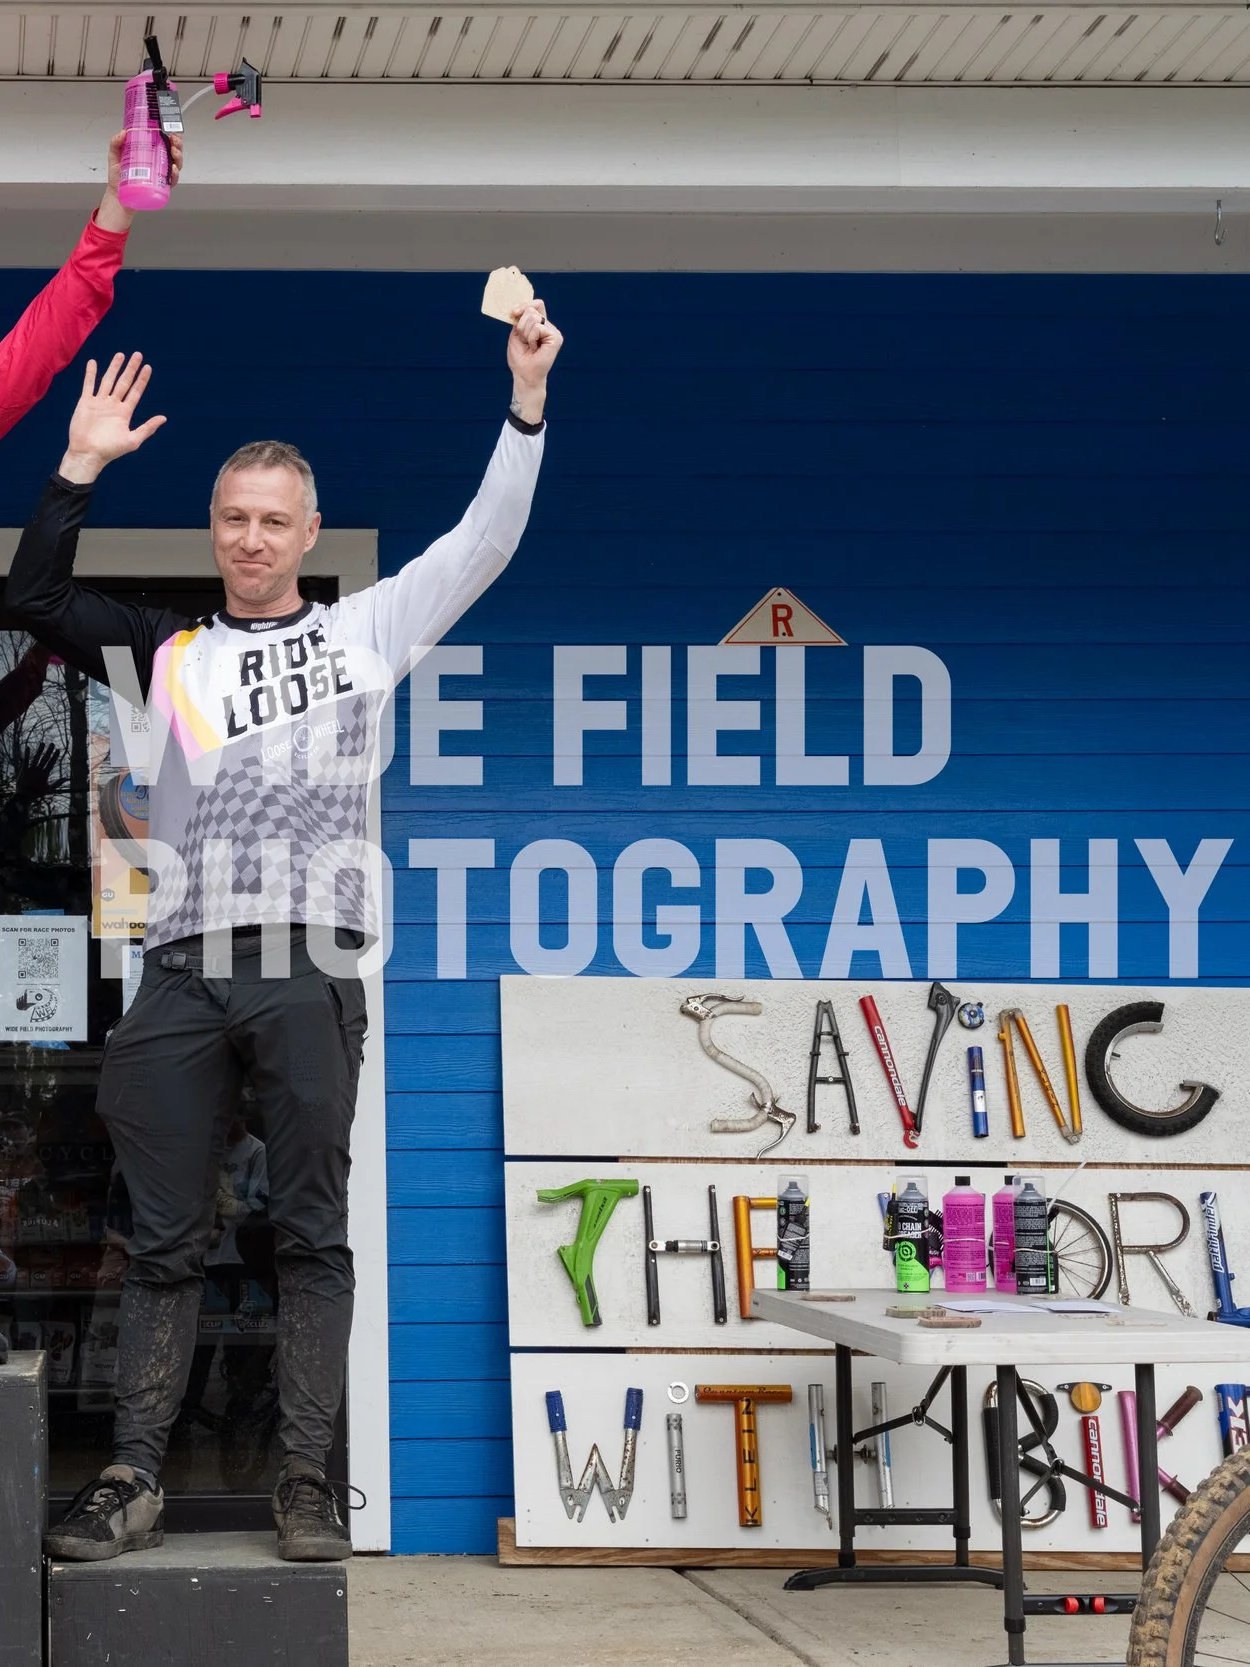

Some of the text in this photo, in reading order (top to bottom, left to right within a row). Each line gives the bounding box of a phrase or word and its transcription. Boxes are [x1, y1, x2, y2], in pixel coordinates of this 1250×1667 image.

[771, 603, 794, 637] R
[238, 623, 328, 687] RIDE
[222, 649, 354, 739] LOOSE
[260, 719, 345, 762] LOOSE WHEEL
[101, 918, 146, 930] wahoo
[873, 1025, 907, 1107] cannondale
[901, 1222, 922, 1231] CHAIN
[1205, 1204, 1225, 1273] pathfinder
[742, 1397, 759, 1524] KLEIN
